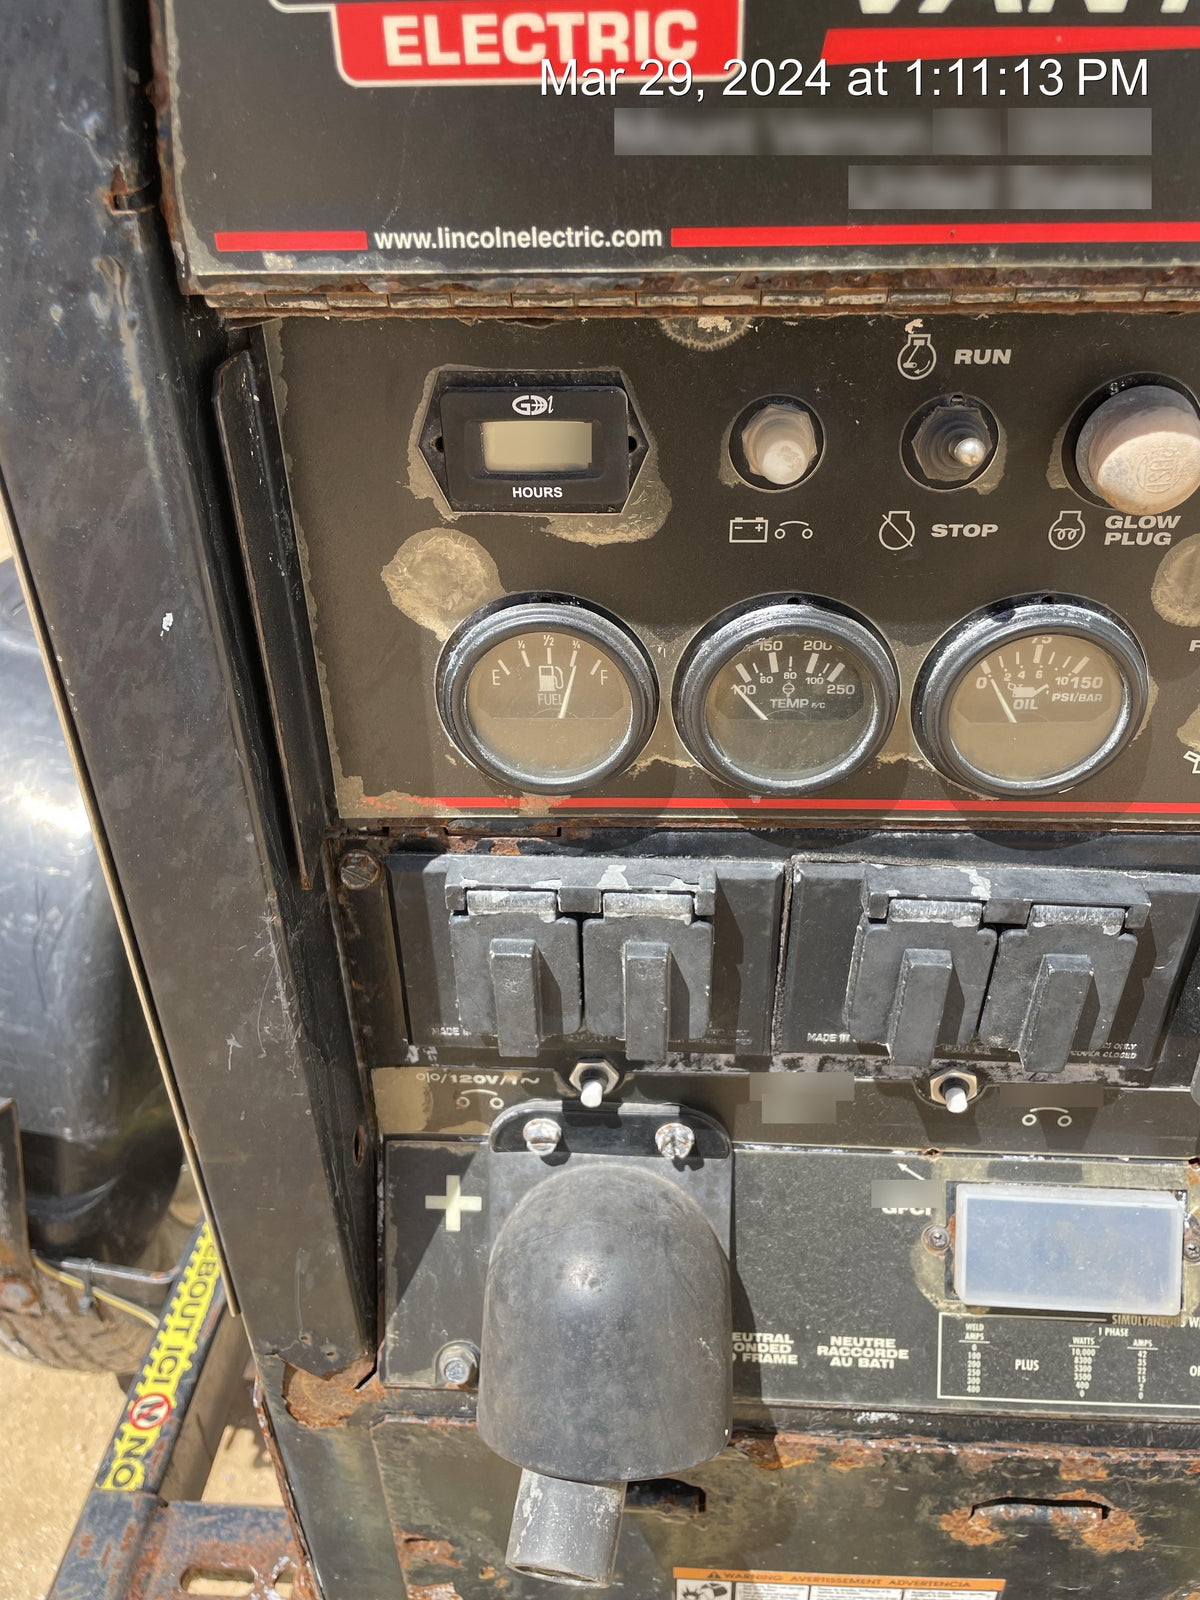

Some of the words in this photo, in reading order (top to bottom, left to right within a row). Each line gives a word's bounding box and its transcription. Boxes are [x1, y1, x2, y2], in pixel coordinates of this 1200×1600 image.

[382, 10, 698, 67] ELECTRIC
[373, 225, 663, 251] www.lincolnelectric.com
[954, 348, 1012, 365] RUN
[512, 486, 563, 499] HOURS
[1104, 515, 1181, 529] GLOW
[931, 523, 999, 538] STOP
[1103, 532, 1172, 546] PLUG
[759, 640, 783, 651] 150
[803, 640, 832, 651] 200
[492, 669, 501, 686] E
[600, 669, 608, 686] F
[760, 675, 773, 684] 60
[783, 671, 797, 680] 80
[1017, 670, 1025, 679] 4
[1035, 670, 1043, 679] 6
[805, 677, 824, 685] 100
[976, 677, 987, 689] 0
[1070, 676, 1104, 689] 150
[826, 684, 855, 695] 250
[537, 693, 563, 706] FUEL
[770, 698, 809, 709] TEMP
[1013, 698, 1038, 710] OIL
[1051, 693, 1103, 703] PSI/BAR
[807, 1032, 838, 1044] MADE
[1189, 1317, 1200, 1328] W
[732, 1332, 794, 1344] EUTRAL
[964, 1332, 985, 1341] AMPS
[1104, 1327, 1129, 1337] PHASE
[830, 1335, 896, 1348] NEUTRE
[1072, 1336, 1095, 1345] WATTS
[1132, 1338, 1153, 1347] AMPS
[732, 1342, 792, 1353] ONDED
[816, 1345, 909, 1359] RACCORDE
[742, 1353, 798, 1365] FRAME
[829, 1356, 853, 1367] AU
[858, 1357, 894, 1369] BATI
[1014, 1358, 1040, 1371] PLUS
[724, 1572, 782, 1582] WARNING
[888, 1579, 972, 1588] ADVERTENCIA
